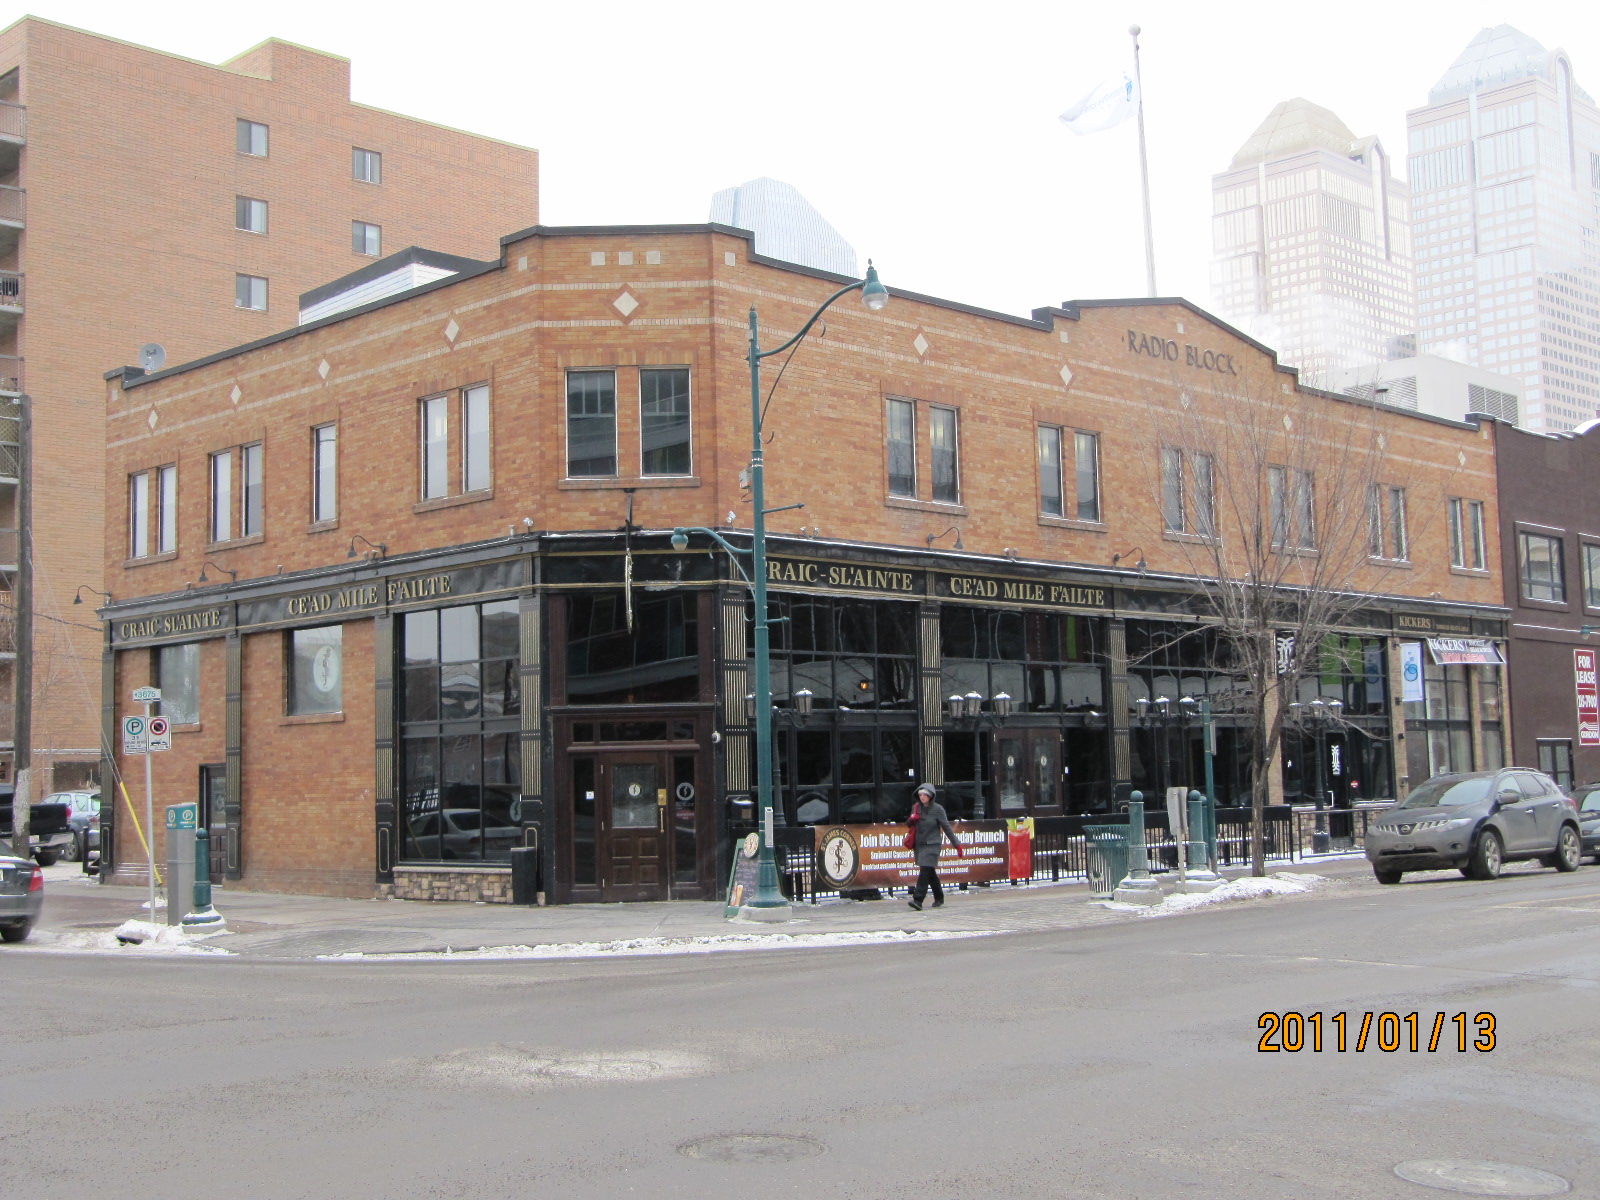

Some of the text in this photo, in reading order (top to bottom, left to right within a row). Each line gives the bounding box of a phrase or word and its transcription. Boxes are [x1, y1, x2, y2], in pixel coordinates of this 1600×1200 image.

[1128, 330, 1237, 376] RADIO BLOCK
[338, 587, 378, 608] MILE
[1004, 582, 1044, 600] MILE
[1399, 616, 1431, 629] KICKERS
[1429, 639, 1465, 652] KICKERS
[1578, 656, 1591, 669] FOR
[1577, 670, 1596, 684] LEASE
[1580, 731, 1599, 739] GORDON
[860, 833, 878, 848] Join
[878, 833, 890, 847] Us
[891, 832, 903, 847] for
[974, 829, 1005, 843] Brunch
